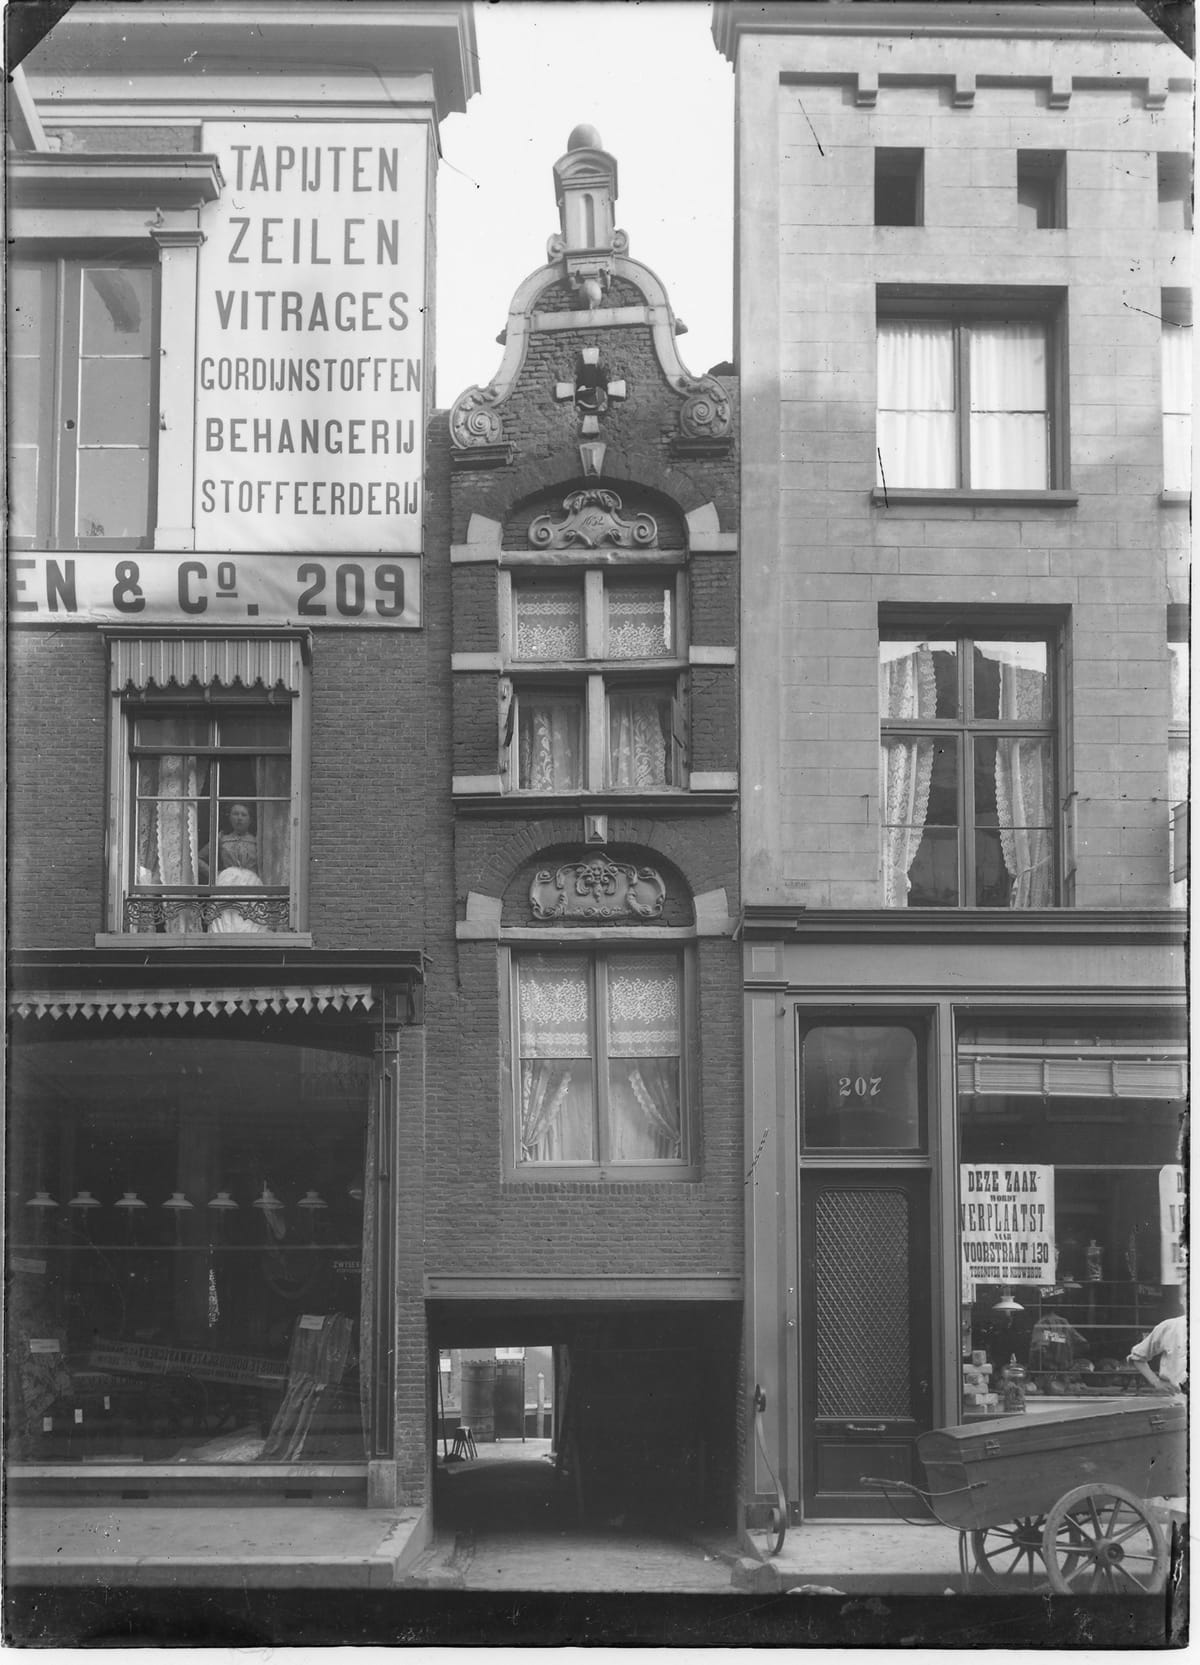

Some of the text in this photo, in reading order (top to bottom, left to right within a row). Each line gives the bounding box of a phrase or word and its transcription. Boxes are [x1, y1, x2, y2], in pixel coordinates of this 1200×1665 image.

[231, 145, 399, 193] TAPIJTEN
[228, 217, 399, 265] ZEILEN
[215, 290, 409, 331] VITRAGES
[201, 357, 421, 392] GORDIJNSTOFFEN
[205, 418, 415, 454] BEHANGERIJ
[201, 480, 418, 515] STOFFEERDERIJ
[10, 559, 79, 613] EN
[112, 560, 146, 614] &
[296, 563, 406, 618] 209
[839, 1076, 882, 1097] 207
[968, 1170, 1037, 1193] DEZE ZAAK
[963, 1242, 1049, 1264] VOORSTRAAT 130
